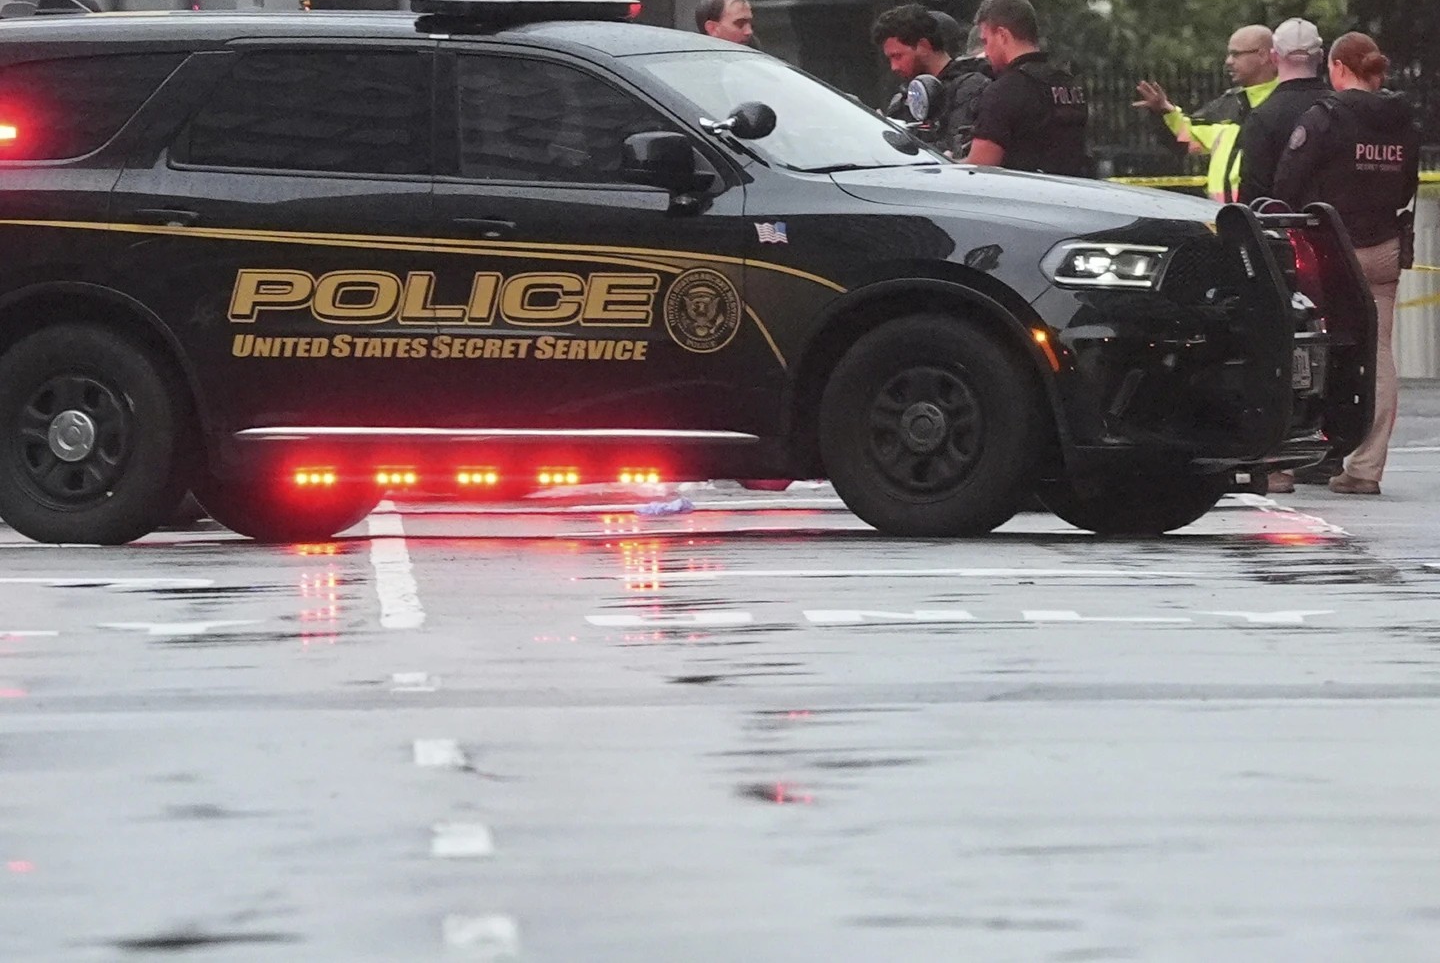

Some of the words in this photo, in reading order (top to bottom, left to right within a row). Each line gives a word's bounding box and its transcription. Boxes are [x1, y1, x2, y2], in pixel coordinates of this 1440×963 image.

[1355, 143, 1404, 162] POLICE
[227, 269, 661, 327] POLICE
[232, 334, 330, 358] UNITED
[331, 334, 429, 359] STATES
[430, 335, 533, 359] SECRET
[533, 336, 649, 361] SERVICE
